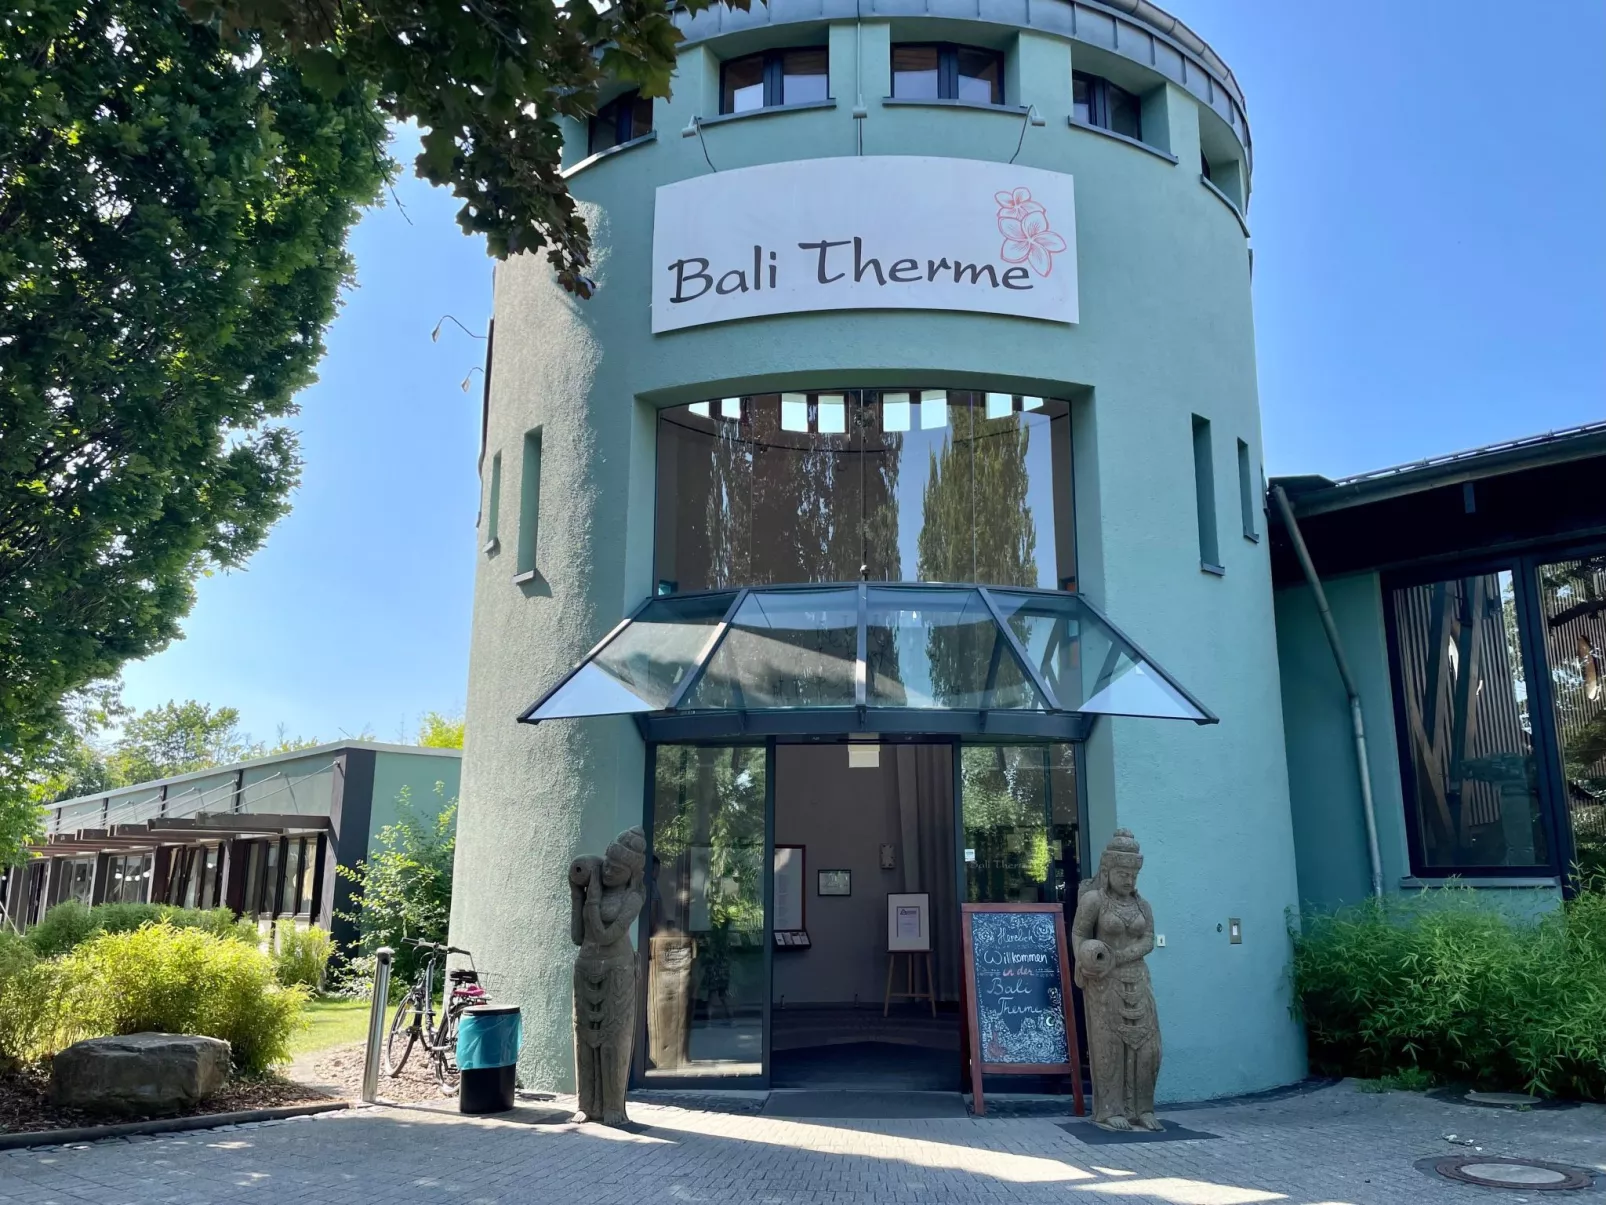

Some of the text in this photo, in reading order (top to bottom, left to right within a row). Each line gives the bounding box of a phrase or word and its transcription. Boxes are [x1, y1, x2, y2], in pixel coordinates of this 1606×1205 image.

[667, 236, 1034, 304] Bali Therme
[997, 927, 1036, 945] Herzlich
[984, 950, 1048, 965] Willkommen
[1002, 965, 1035, 977] in der
[986, 977, 1033, 995] Bali
[998, 996, 1043, 1015] Therme
